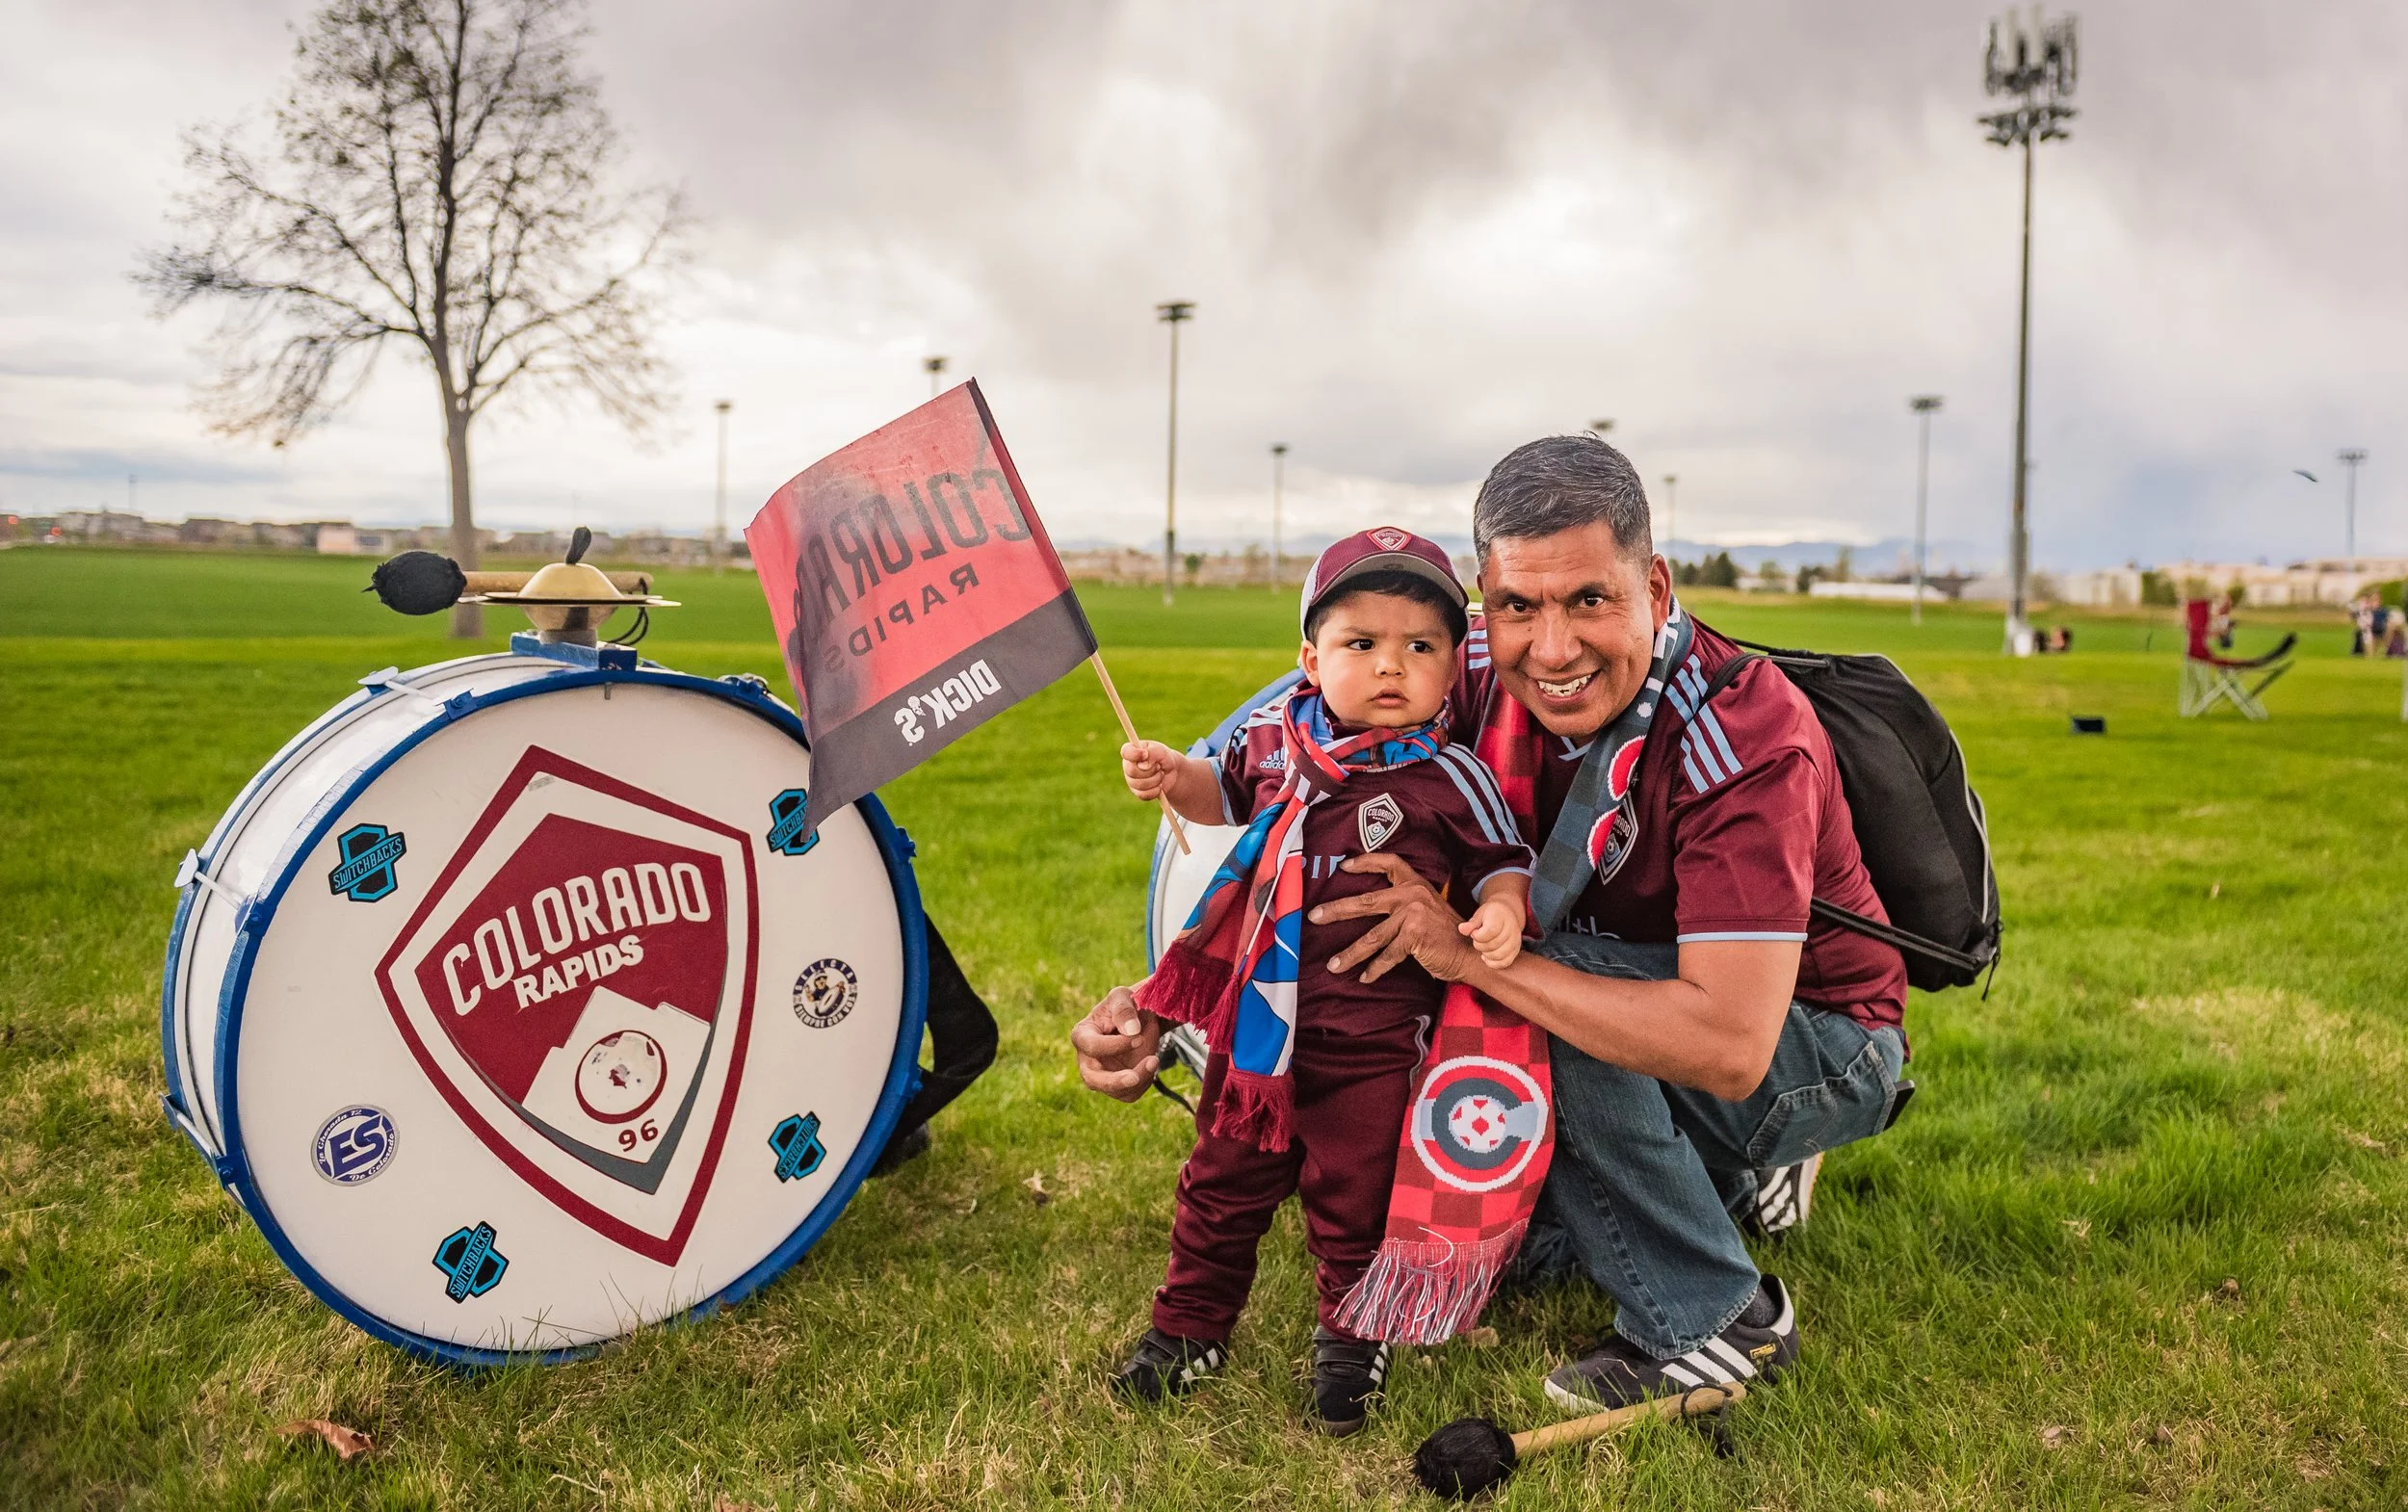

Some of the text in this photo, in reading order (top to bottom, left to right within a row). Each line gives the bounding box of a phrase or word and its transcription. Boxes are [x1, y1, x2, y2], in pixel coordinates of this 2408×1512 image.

[1260, 759, 1285, 770] adida
[770, 807, 807, 847] SWITCHBA
[333, 837, 403, 889] SWITCHBACKS
[443, 862, 711, 1016] COLORADO
[513, 934, 644, 1008] RAPIDS
[327, 1115, 385, 1180] ES
[368, 1133, 395, 1175] Colorado
[617, 1118, 659, 1152] 96
[450, 1226, 492, 1298] SWITCHBACKS
